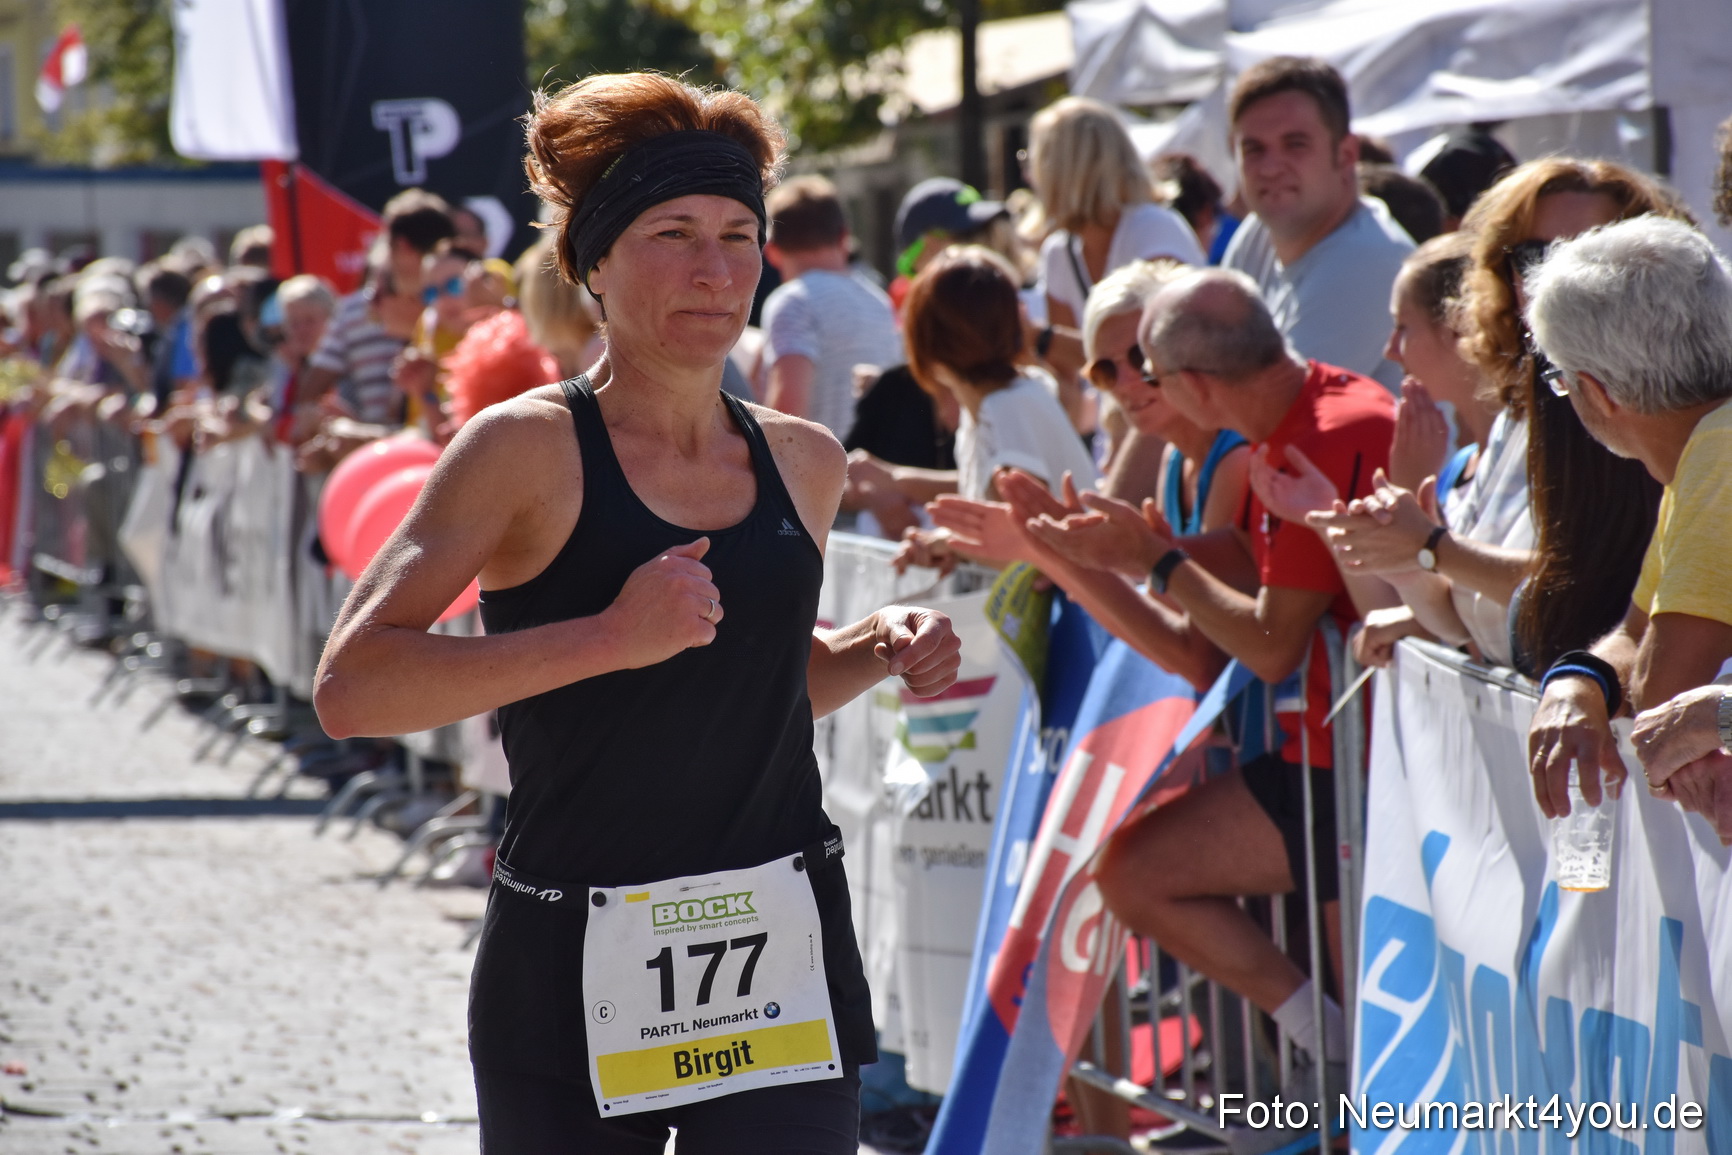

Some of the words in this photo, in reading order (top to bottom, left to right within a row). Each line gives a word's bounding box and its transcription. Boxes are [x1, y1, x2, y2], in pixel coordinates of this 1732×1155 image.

[495, 870, 536, 895] unlimited
[652, 891, 757, 927] BOCK
[653, 924, 685, 936] inspired
[699, 921, 723, 931] smart
[724, 915, 759, 927] concepts
[646, 932, 768, 1012] 177
[600, 1006, 608, 1019] C
[640, 1022, 689, 1039] PARTL
[692, 1008, 759, 1031] Neumarkt
[673, 1040, 754, 1079] Birgit
